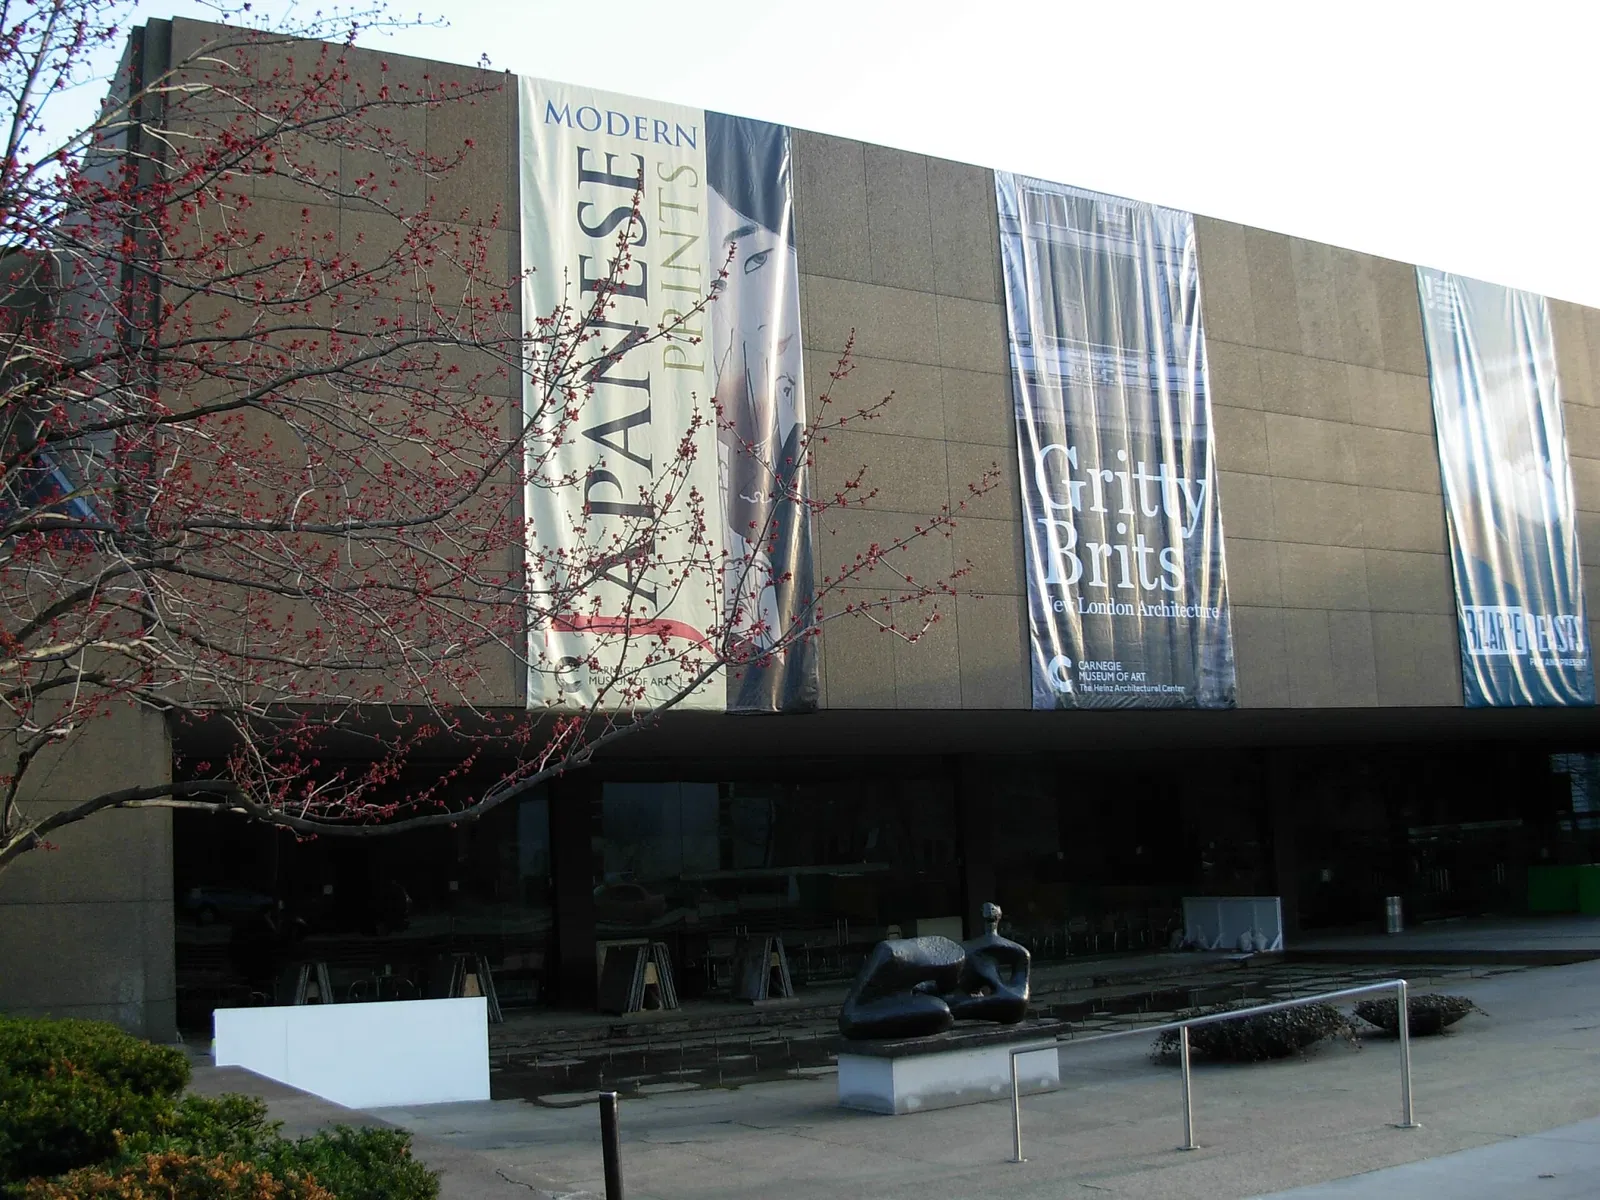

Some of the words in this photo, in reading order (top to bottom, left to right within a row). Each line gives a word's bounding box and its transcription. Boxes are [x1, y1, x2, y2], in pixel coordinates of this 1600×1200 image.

[544, 99, 698, 150] MODERN
[656, 161, 705, 373] PRINTS
[1035, 443, 1207, 539] Gritty
[1037, 517, 1186, 591] Brits
[1077, 596, 1135, 616] London
[1136, 599, 1220, 619] Architecture
[1078, 660, 1122, 671] CARNEGIE
[1078, 671, 1115, 682] MUSEUM
[1116, 672, 1129, 681] OF
[1130, 672, 1146, 682] ART
[588, 676, 630, 686] MUSUM
[635, 677, 648, 686] OF
[650, 677, 669, 687] ART
[1079, 683, 1092, 692] The
[1093, 684, 1113, 692] Heinz
[1114, 684, 1161, 692] Architectural
[1162, 684, 1185, 693] Center
